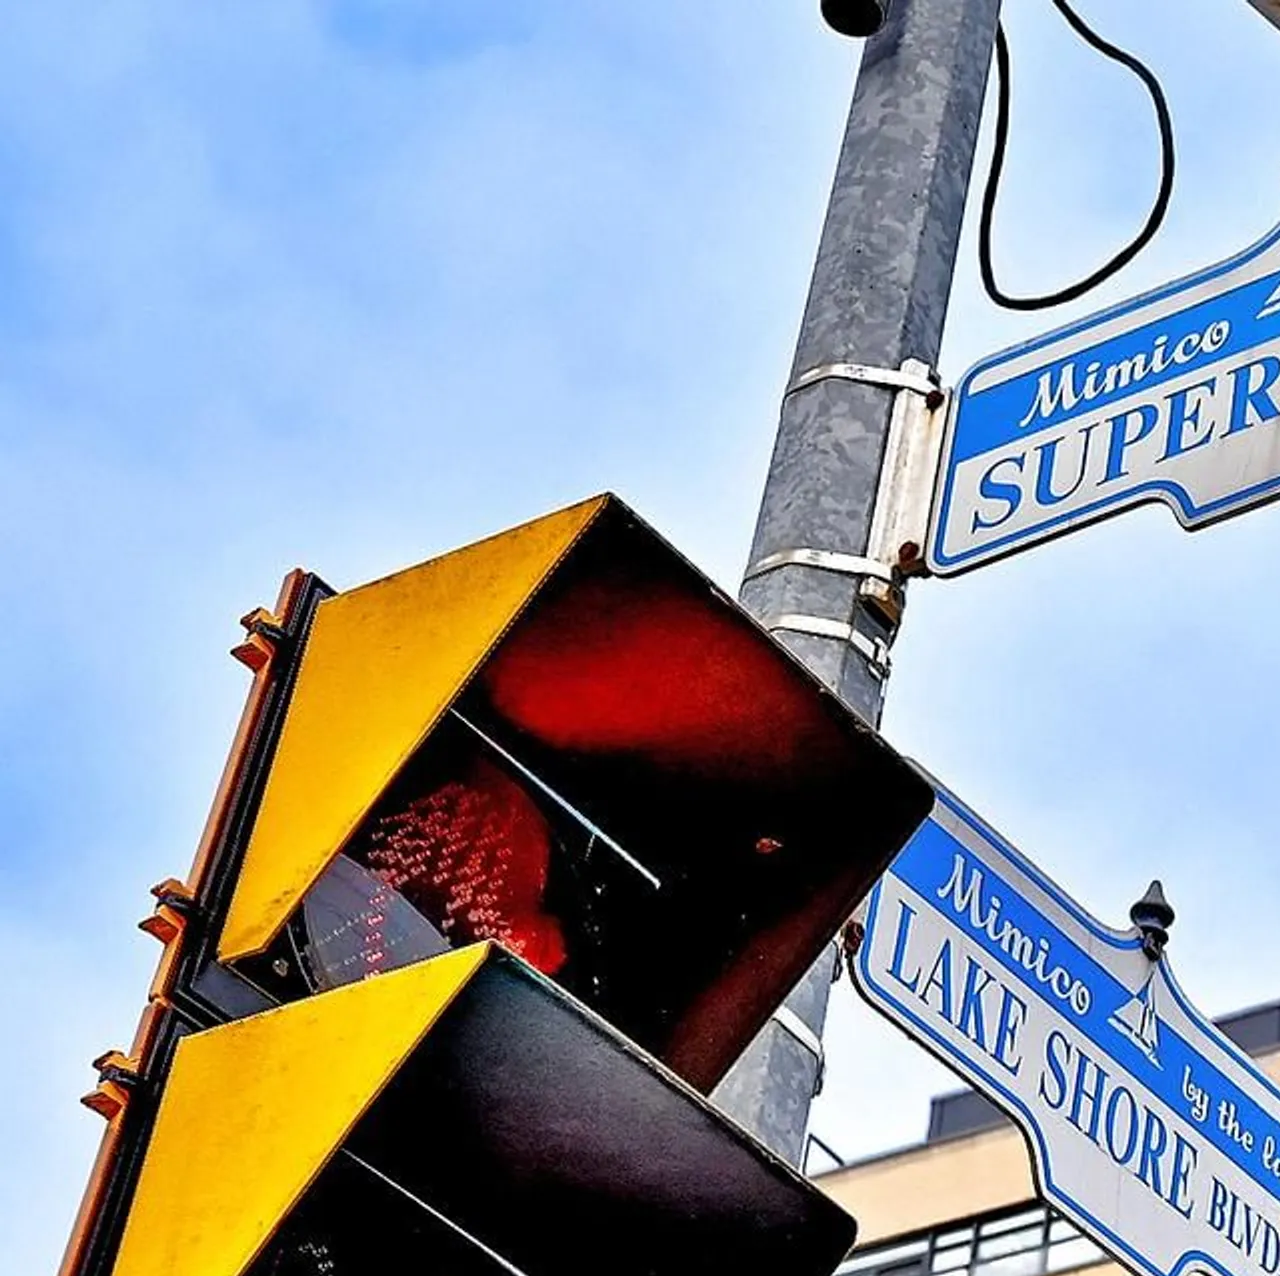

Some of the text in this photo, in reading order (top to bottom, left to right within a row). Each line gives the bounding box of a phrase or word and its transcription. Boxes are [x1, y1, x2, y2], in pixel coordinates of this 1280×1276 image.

[1019, 316, 1231, 428] Mimico
[885, 896, 1028, 1076] LAKE
[1037, 1028, 1199, 1221] SHORE
[936, 852, 1093, 1018] Mimico
[1181, 1064, 1210, 1122] by
[1216, 1098, 1254, 1153] the
